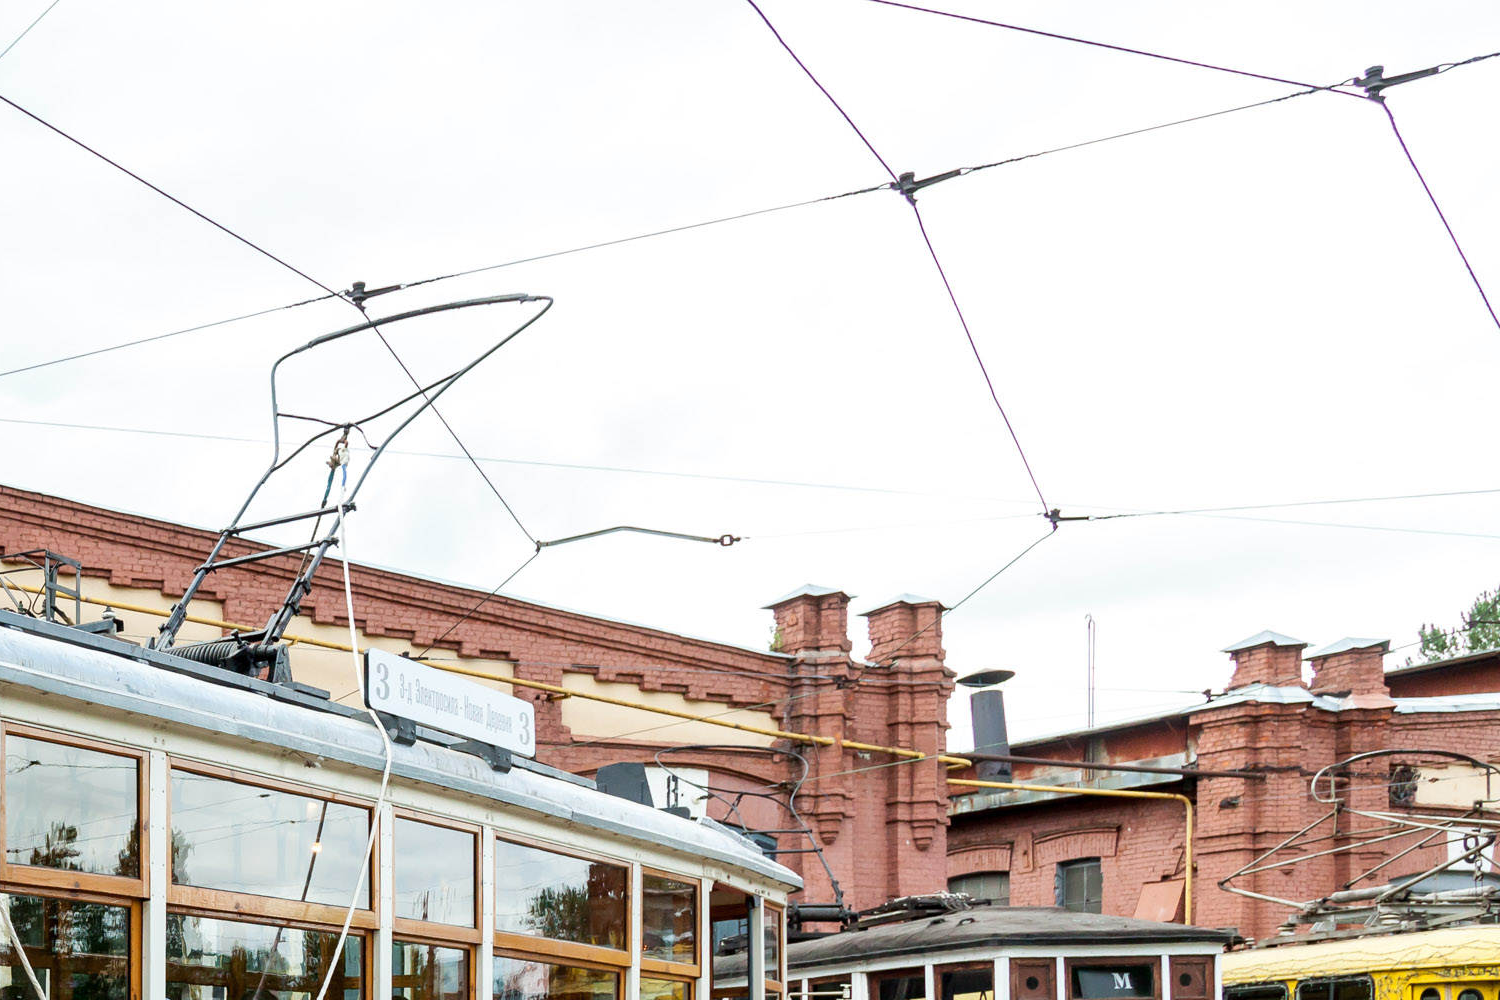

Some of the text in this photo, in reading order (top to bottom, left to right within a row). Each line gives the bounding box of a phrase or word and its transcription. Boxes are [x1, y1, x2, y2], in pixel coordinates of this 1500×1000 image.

[376, 662, 390, 700] 3
[415, 678, 459, 716] Электросила
[464, 694, 484, 724] Новая
[519, 711, 531, 745] 3
